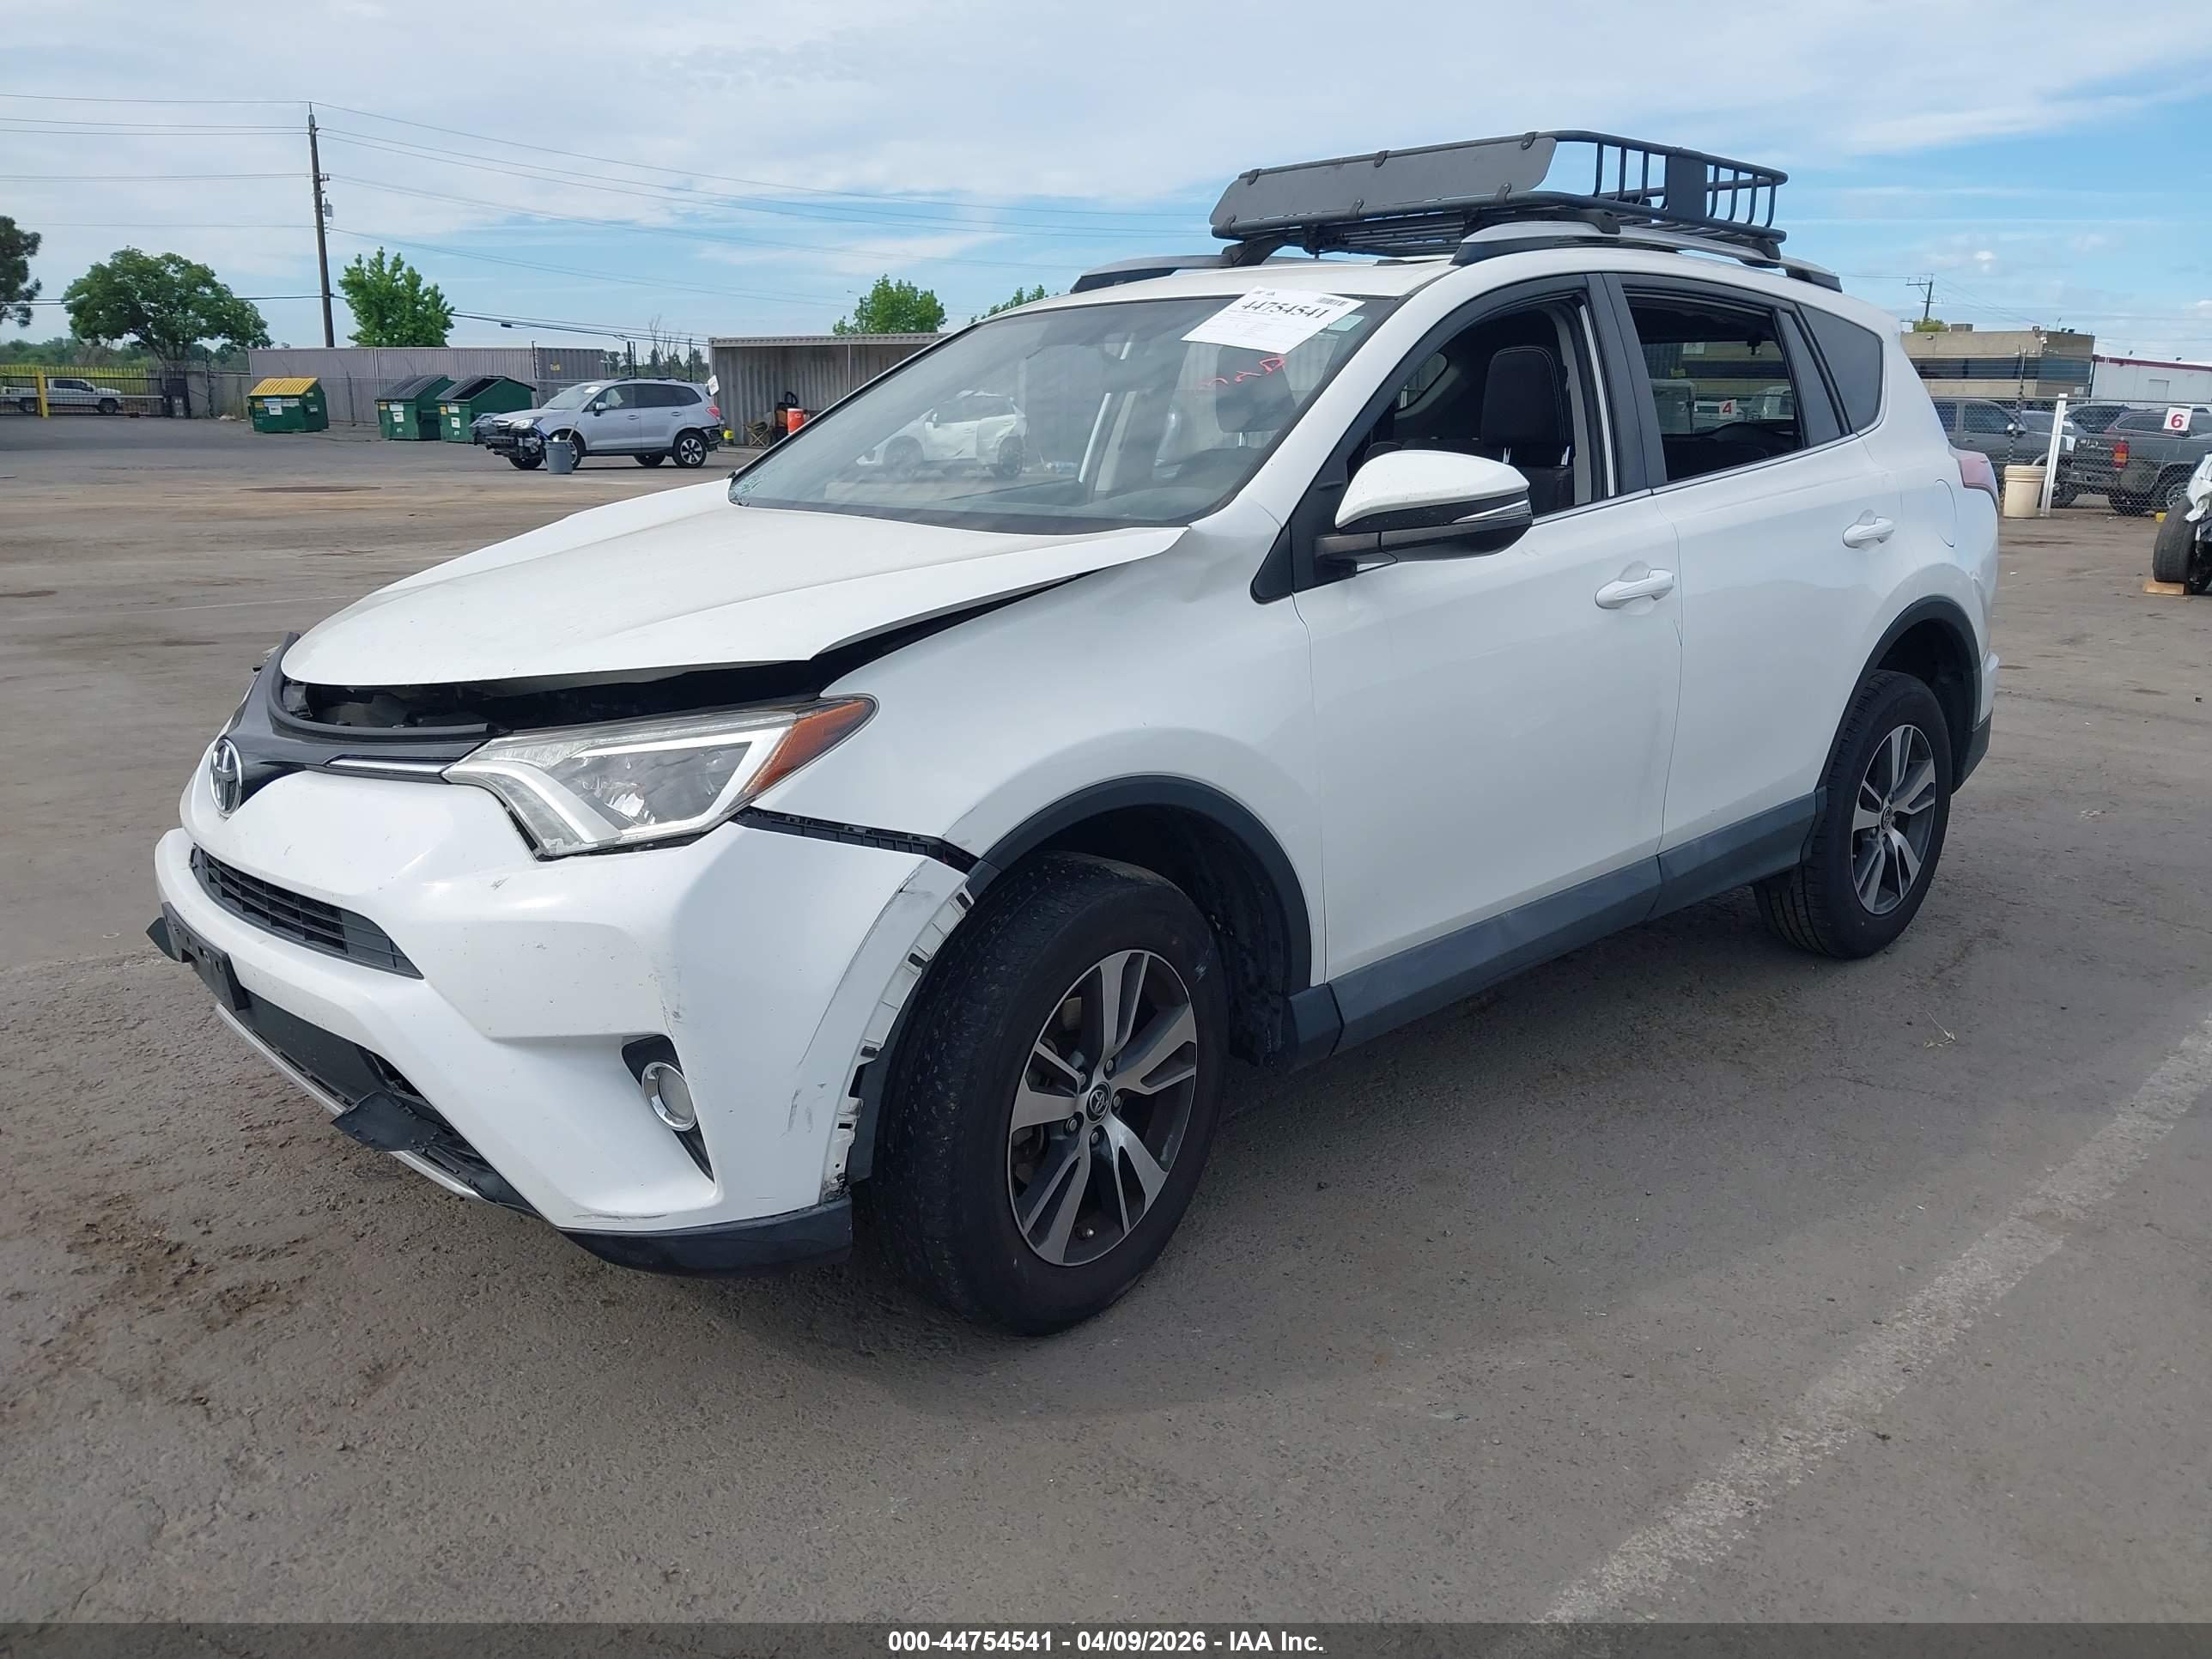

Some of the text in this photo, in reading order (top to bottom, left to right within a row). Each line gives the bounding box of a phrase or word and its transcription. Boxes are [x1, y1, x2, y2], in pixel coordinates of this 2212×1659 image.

[1242, 301, 1330, 319] 44754541
[1722, 402, 1732, 414] 4
[2171, 414, 2185, 428] 6
